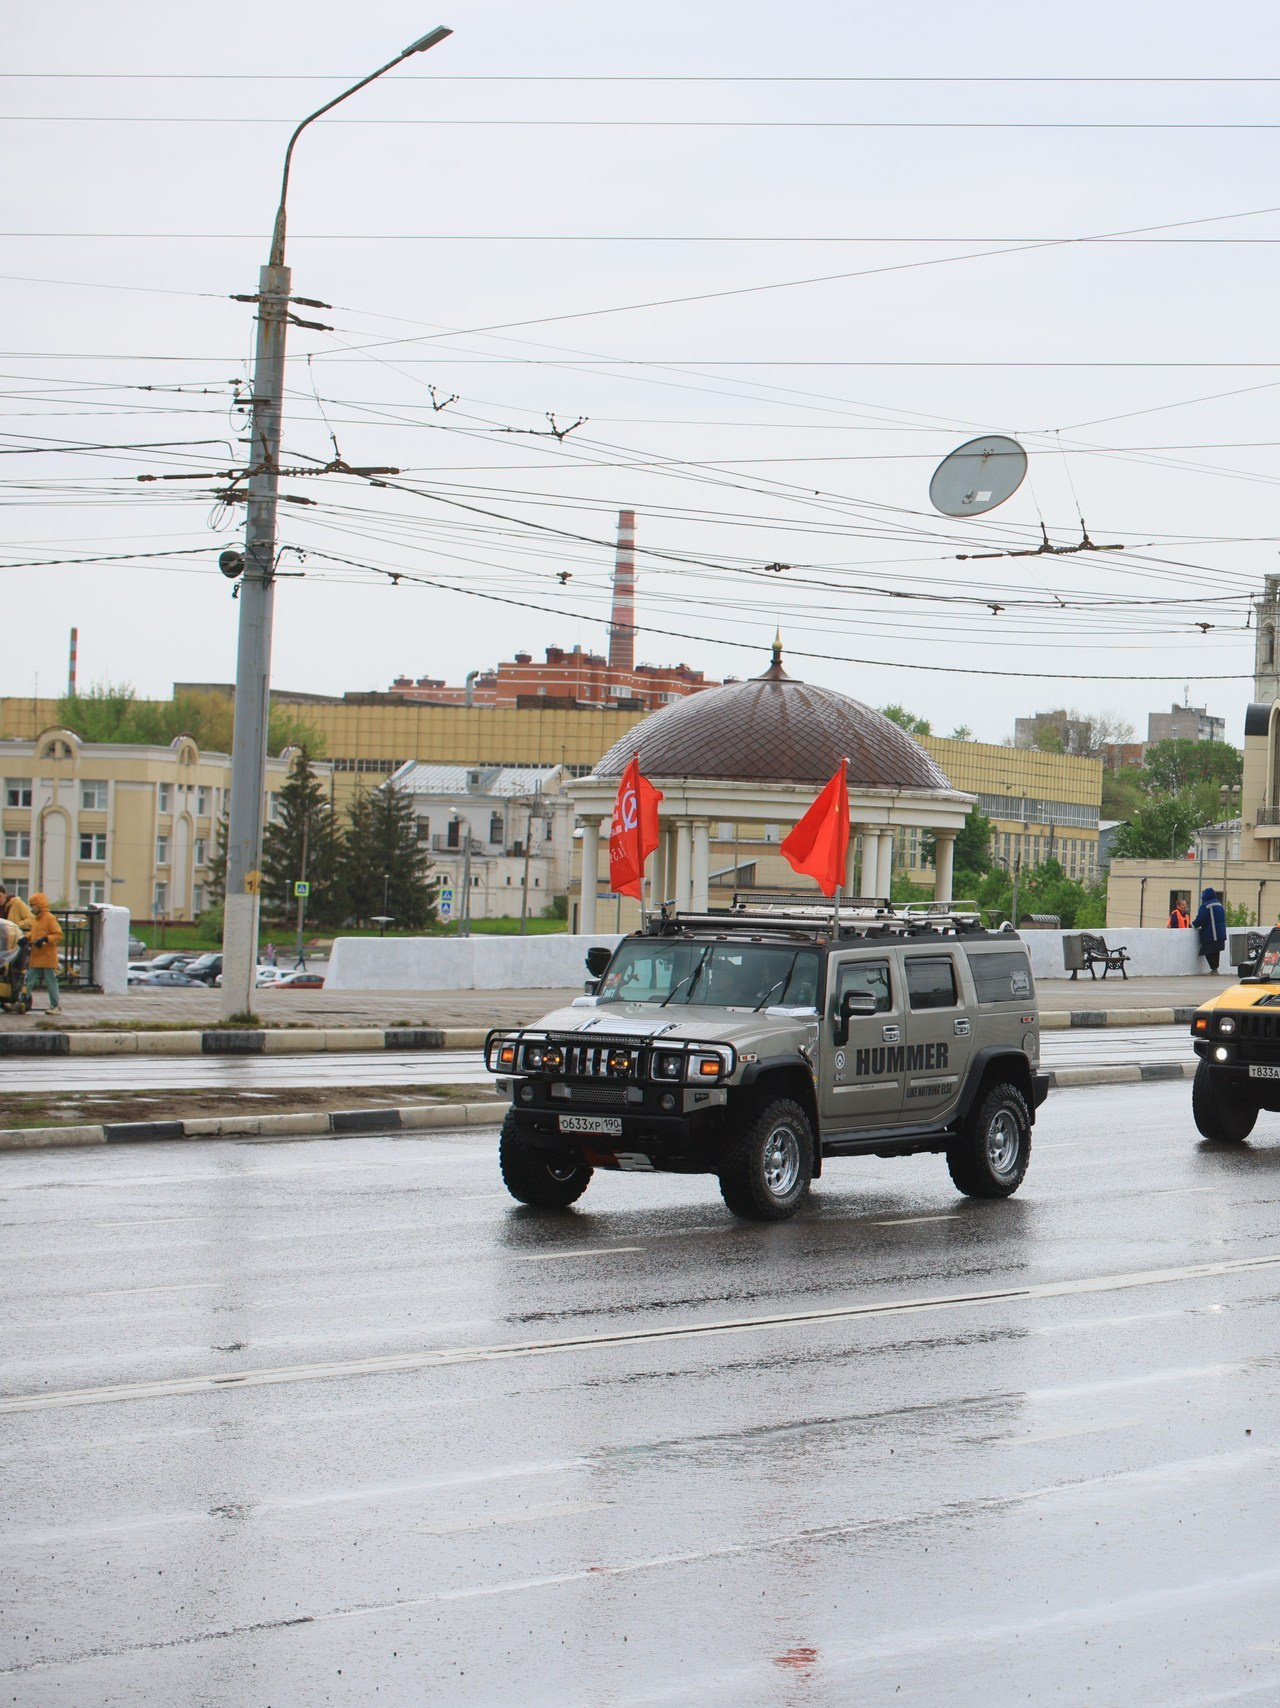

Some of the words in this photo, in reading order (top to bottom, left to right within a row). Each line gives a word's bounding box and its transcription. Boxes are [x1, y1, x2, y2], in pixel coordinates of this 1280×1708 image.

[856, 1042, 949, 1076] HUMMER
[906, 1087, 917, 1098] LIKE
[918, 1085, 940, 1097] NOTHING
[941, 1083, 952, 1095] ELSE
[603, 1118, 619, 1129] 190
